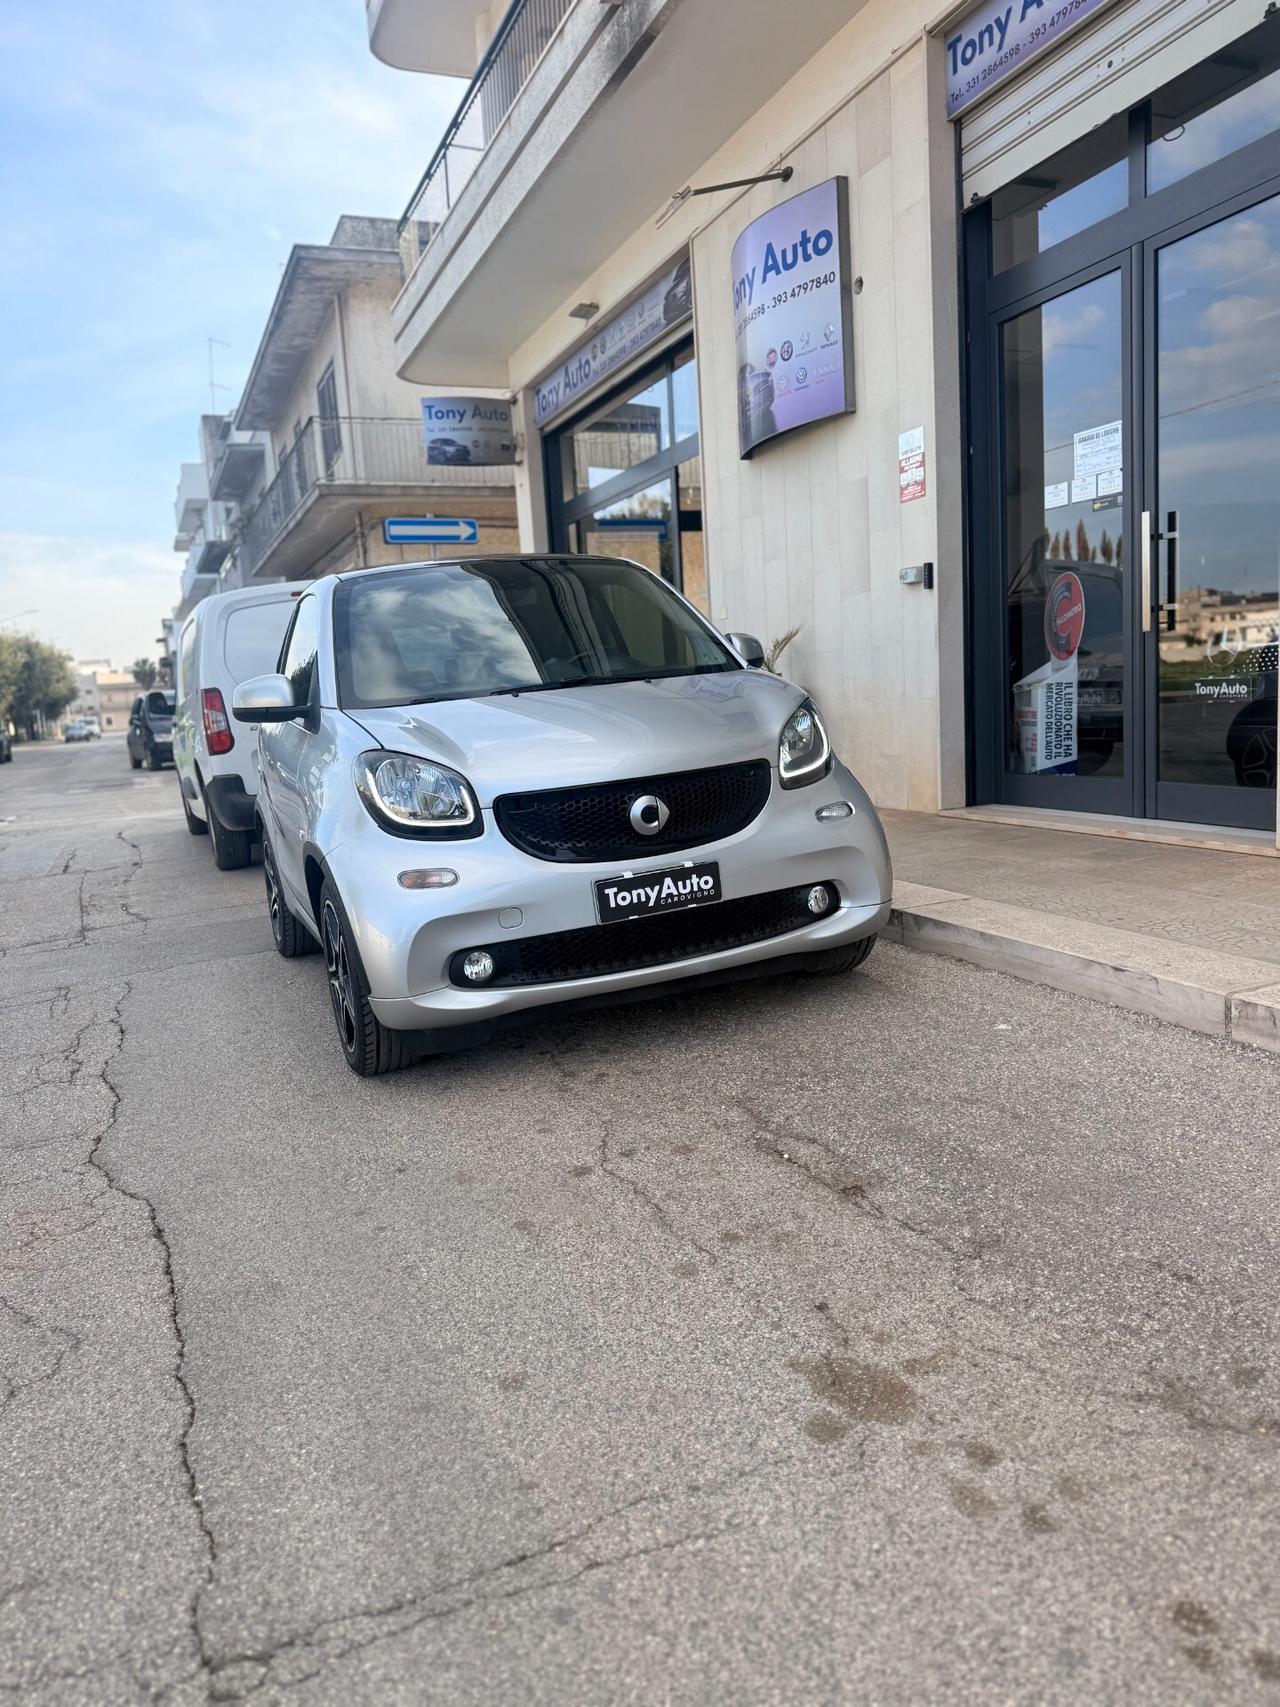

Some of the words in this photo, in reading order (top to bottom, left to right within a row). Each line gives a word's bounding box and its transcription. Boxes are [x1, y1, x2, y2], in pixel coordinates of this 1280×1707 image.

[947, 6, 1013, 76] Tony
[950, 88, 964, 103] Tel.
[966, 75, 980, 92] 331
[981, 44, 1021, 81] 2864598
[1029, 24, 1047, 44] 393
[761, 229, 833, 285] Auto
[771, 291, 788, 308] 393
[790, 271, 836, 299] 4797840
[535, 381, 561, 416] Tony
[563, 358, 591, 397] Auto
[424, 405, 466, 423] Tony
[471, 404, 509, 421] Auto
[1045, 683, 1053, 719] MERCATO
[1063, 682, 1073, 691] IL
[1194, 682, 1248, 698] TonyAuto
[1054, 682, 1063, 749] RIVOLUZIONATO
[1063, 692, 1073, 721] LIBRO
[1045, 721, 1053, 760] DELL'AUTO
[1063, 723, 1073, 743] CHE
[1054, 751, 1063, 759] IL
[1063, 744, 1073, 758] HA
[604, 874, 713, 908] TonyAuto
[661, 889, 715, 905] CAROVIGNO
